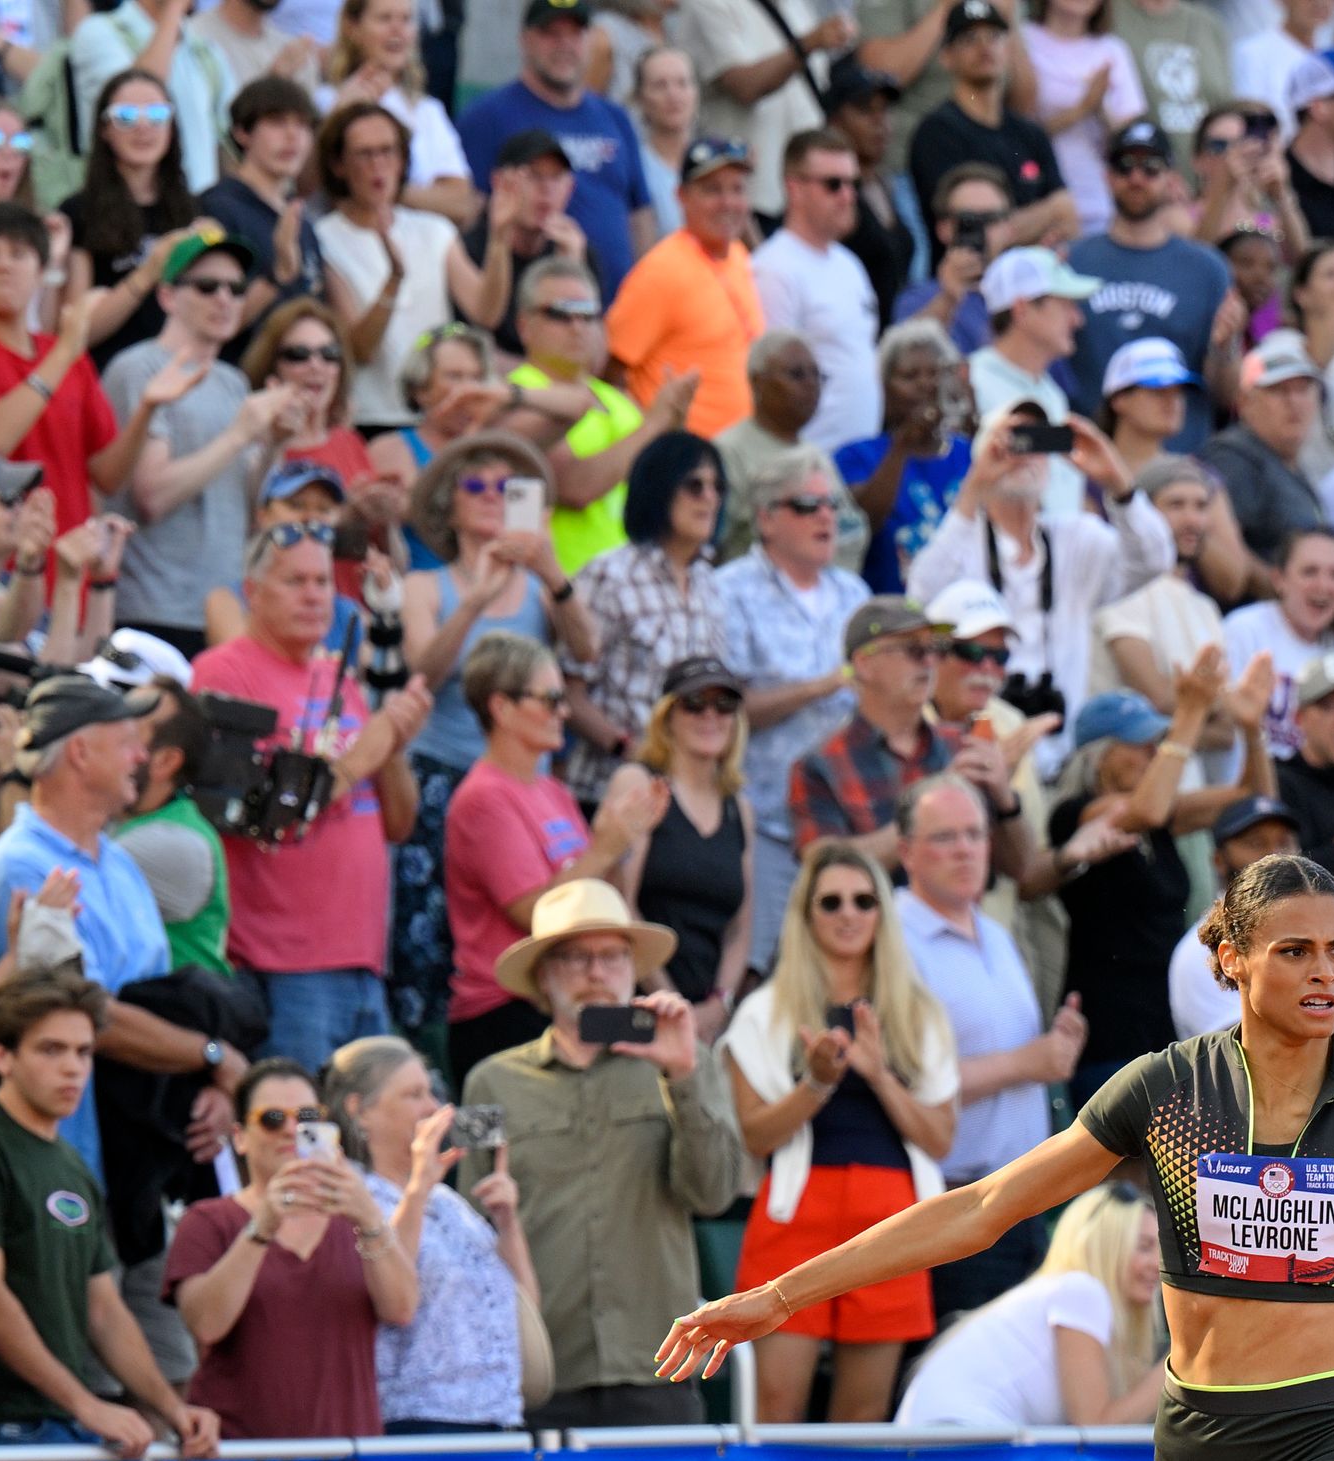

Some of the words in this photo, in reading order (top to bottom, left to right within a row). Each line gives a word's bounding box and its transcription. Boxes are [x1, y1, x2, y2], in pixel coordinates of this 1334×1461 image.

[1221, 1164, 1252, 1175] USATF
[1306, 1164, 1319, 1173] U.S.
[1306, 1173, 1326, 1182] TEAM
[1231, 1223, 1319, 1252] LEVRONE
[1208, 1248, 1249, 1266] TRACKTOWN
[1228, 1262, 1247, 1274] 2024
